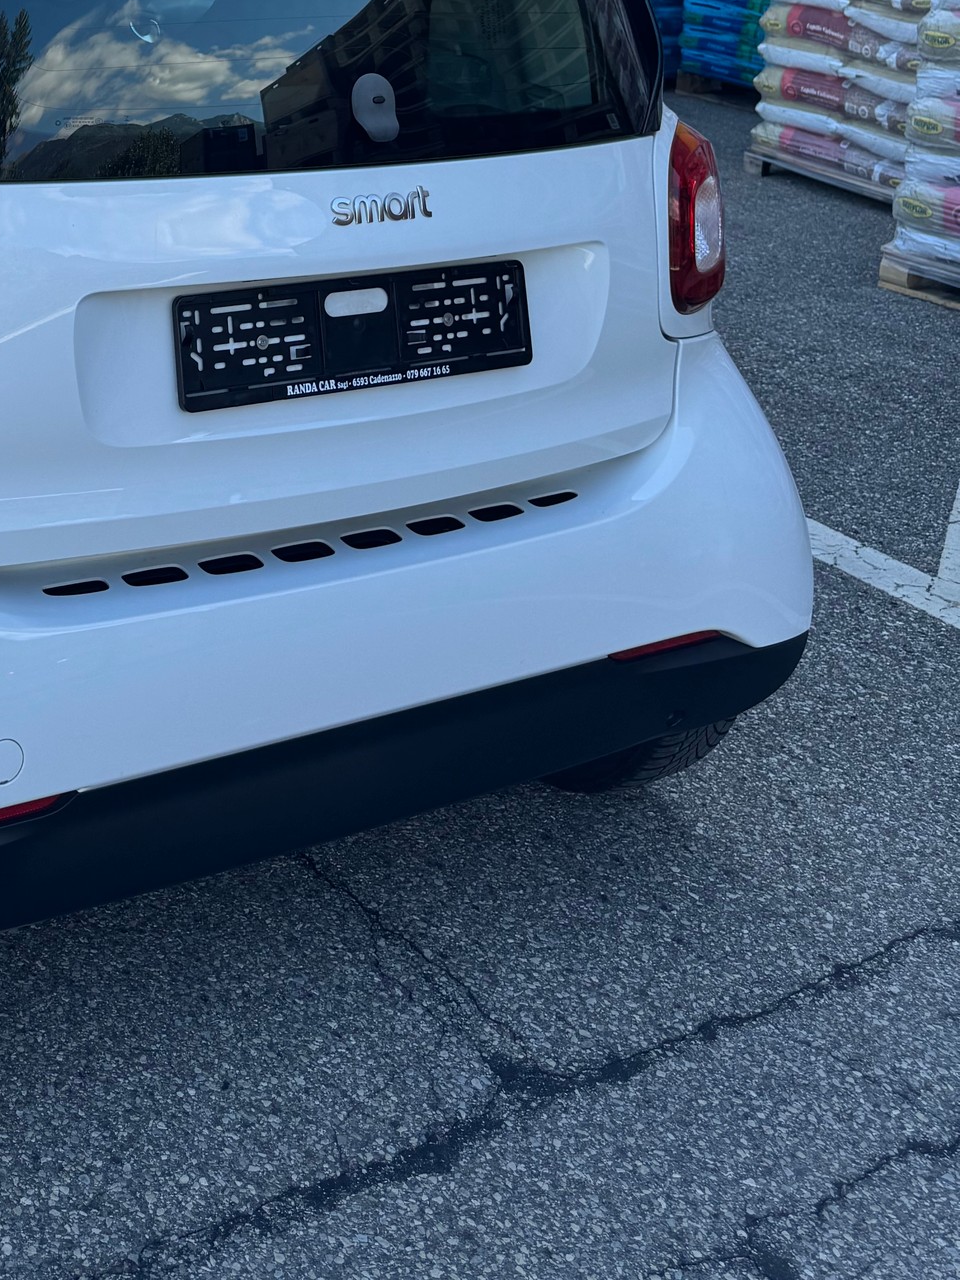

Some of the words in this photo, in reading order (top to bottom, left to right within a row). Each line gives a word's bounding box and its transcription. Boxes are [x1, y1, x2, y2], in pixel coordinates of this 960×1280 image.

[330, 185, 433, 226] smart
[286, 382, 318, 396] RANDA
[319, 379, 337, 392] CAR
[352, 376, 369, 387] 6593
[369, 373, 402, 385] Cadenazzo
[406, 369, 419, 379] 079
[420, 367, 432, 377] 667
[432, 366, 441, 376] 16
[441, 364, 451, 374] 65
